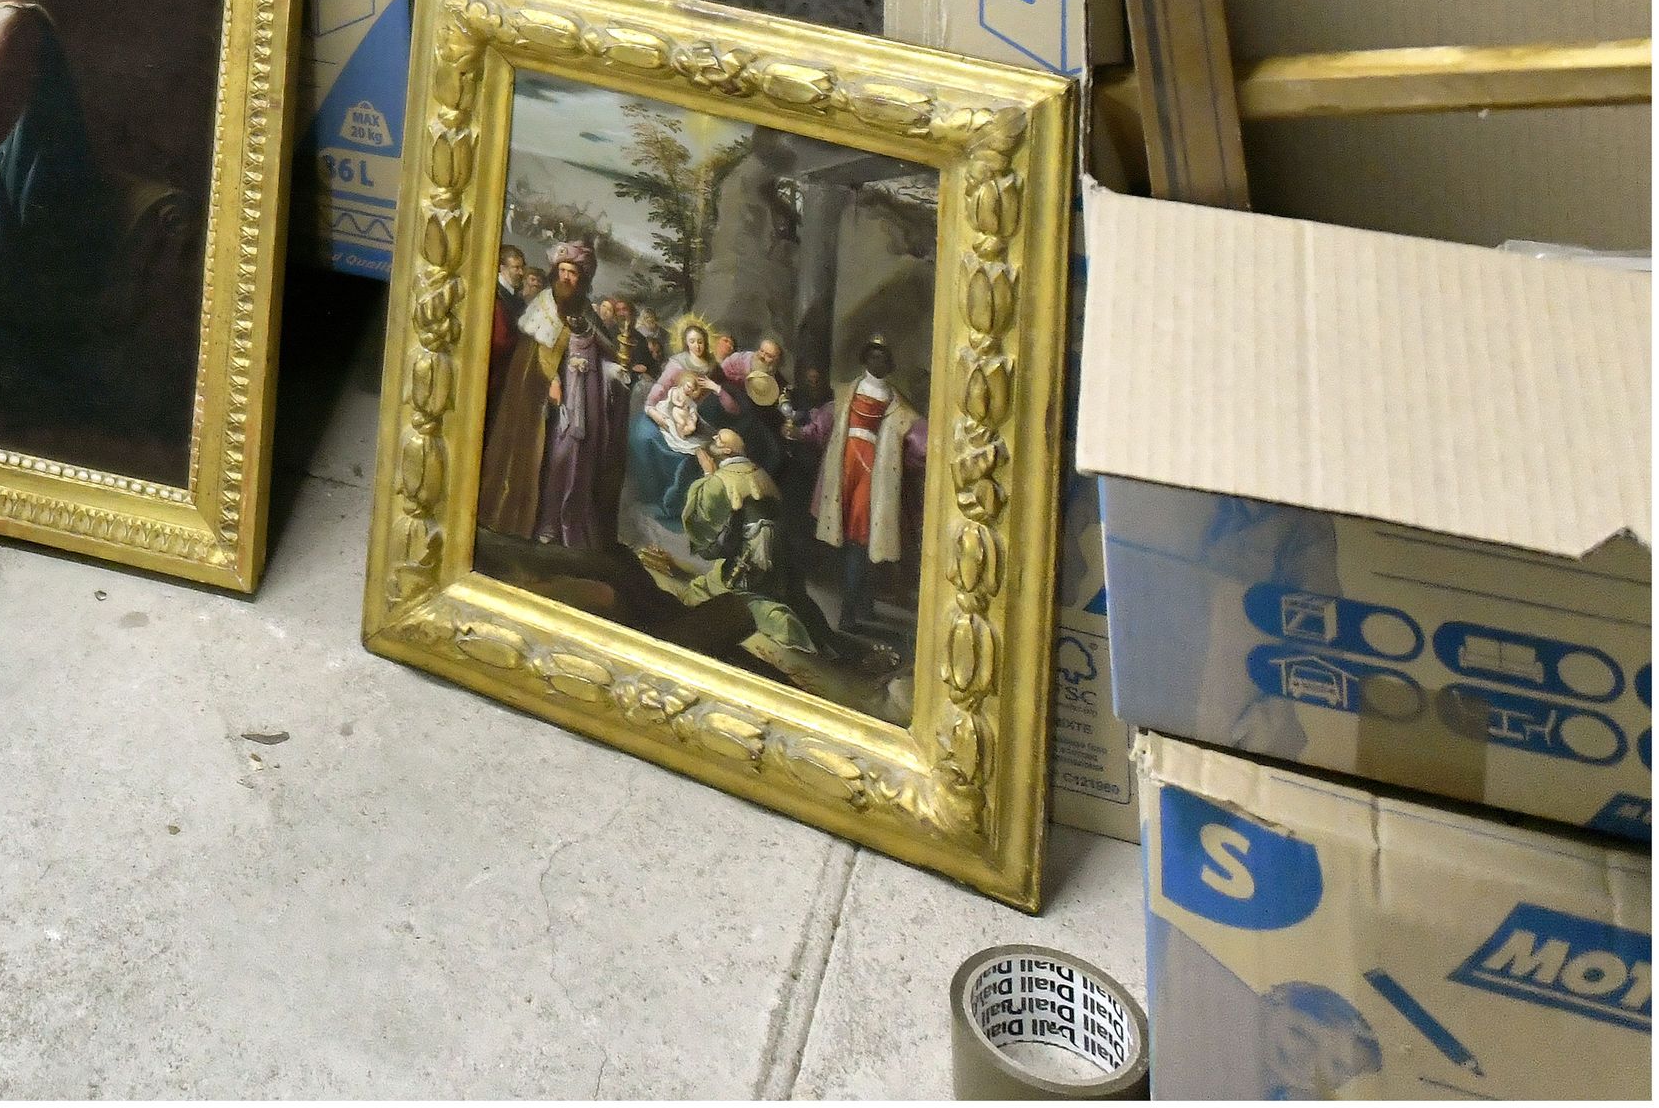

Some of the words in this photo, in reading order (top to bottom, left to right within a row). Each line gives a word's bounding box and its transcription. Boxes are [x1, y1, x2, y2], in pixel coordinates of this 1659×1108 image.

[351, 125, 366, 139] 20
[367, 129, 383, 145] kg
[352, 112, 381, 128] MAX
[1200, 823, 1255, 901] S
[1020, 976, 1075, 1004] Diall
[1082, 992, 1124, 1043] Diall
[1082, 1013, 1125, 1062] Diall
